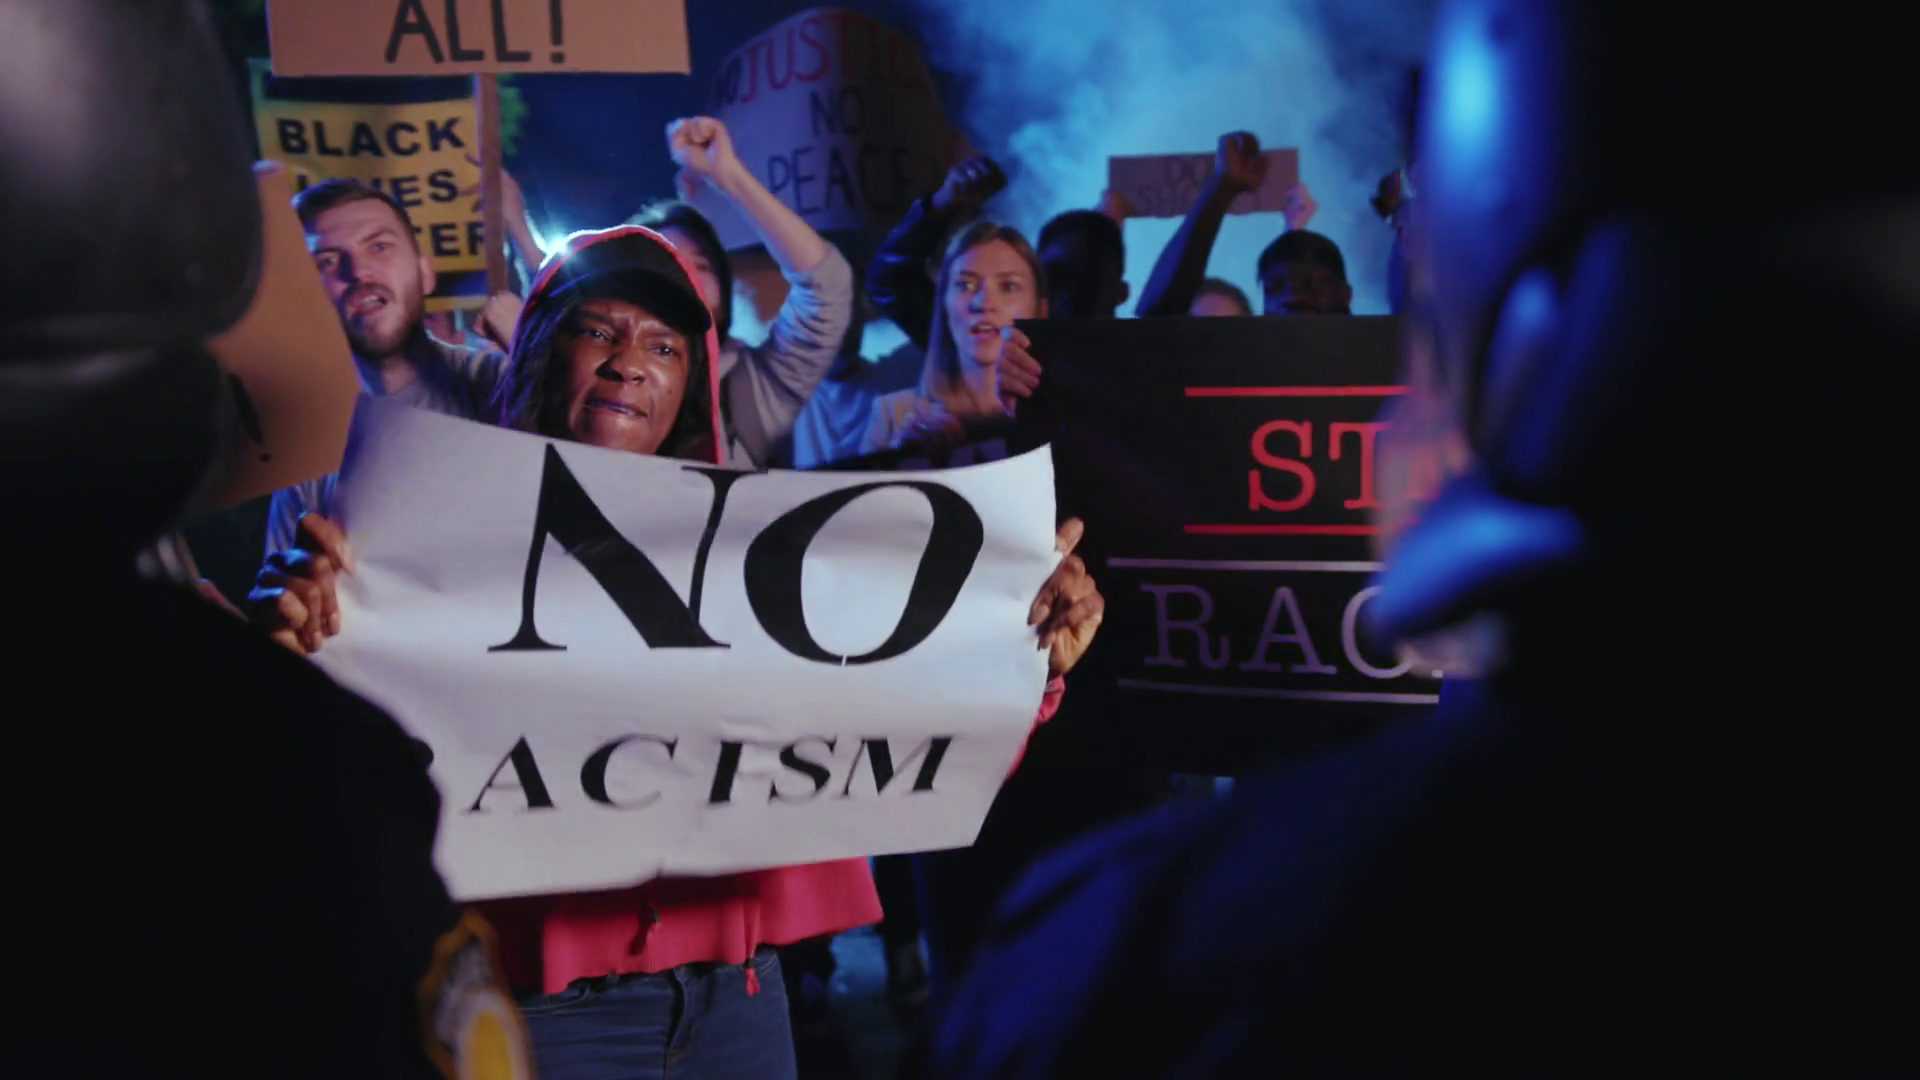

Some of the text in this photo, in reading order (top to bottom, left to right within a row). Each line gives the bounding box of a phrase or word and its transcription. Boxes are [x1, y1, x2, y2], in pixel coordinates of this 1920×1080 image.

[384, 0, 566, 64] ALL!
[276, 116, 466, 158] BLACK
[809, 84, 864, 138] NO
[1247, 419, 1392, 512] ST
[487, 443, 984, 666] NO
[1139, 582, 1443, 679] RAC
[424, 732, 962, 818] ACISM
